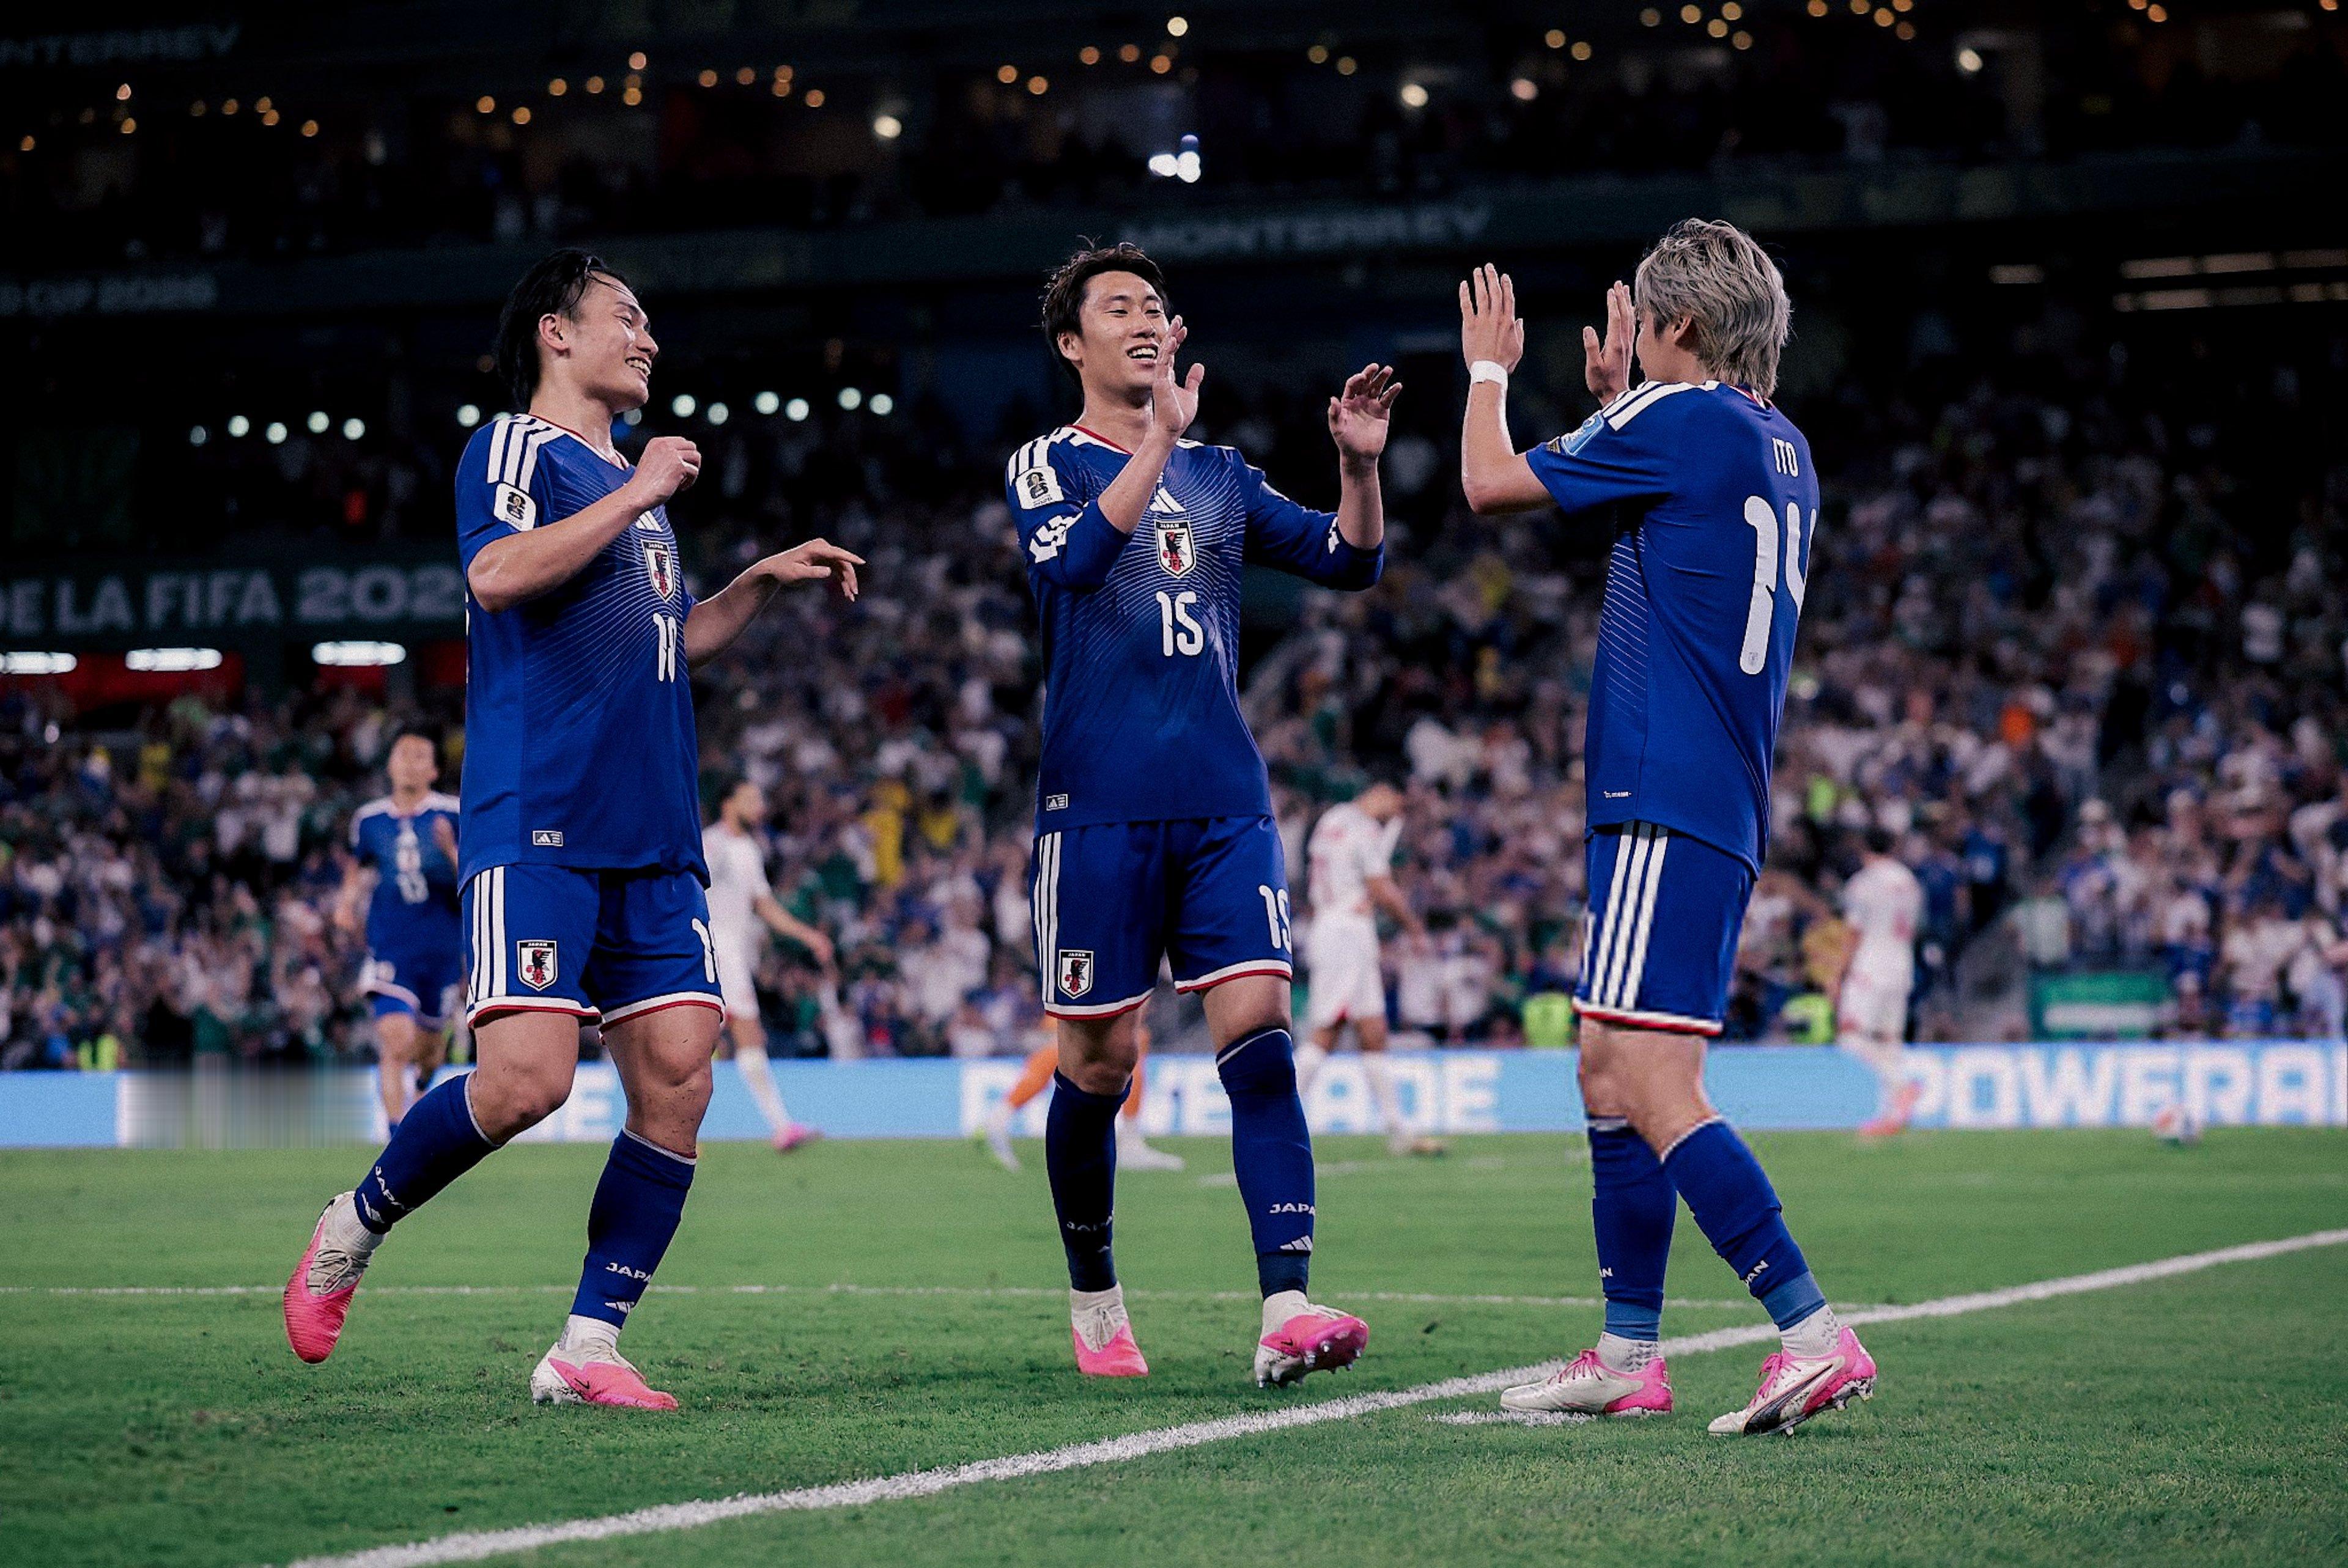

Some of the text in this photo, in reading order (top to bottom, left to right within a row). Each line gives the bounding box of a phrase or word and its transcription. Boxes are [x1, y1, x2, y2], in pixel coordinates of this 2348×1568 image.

[1771, 436, 1799, 477] ITO
[55, 573, 133, 634] LA
[146, 567, 282, 630] FIFA
[1156, 591, 1203, 656] 15
[652, 613, 677, 683] 11
[1258, 885, 1292, 954] 15
[1892, 1047, 2348, 1126] POWERA
